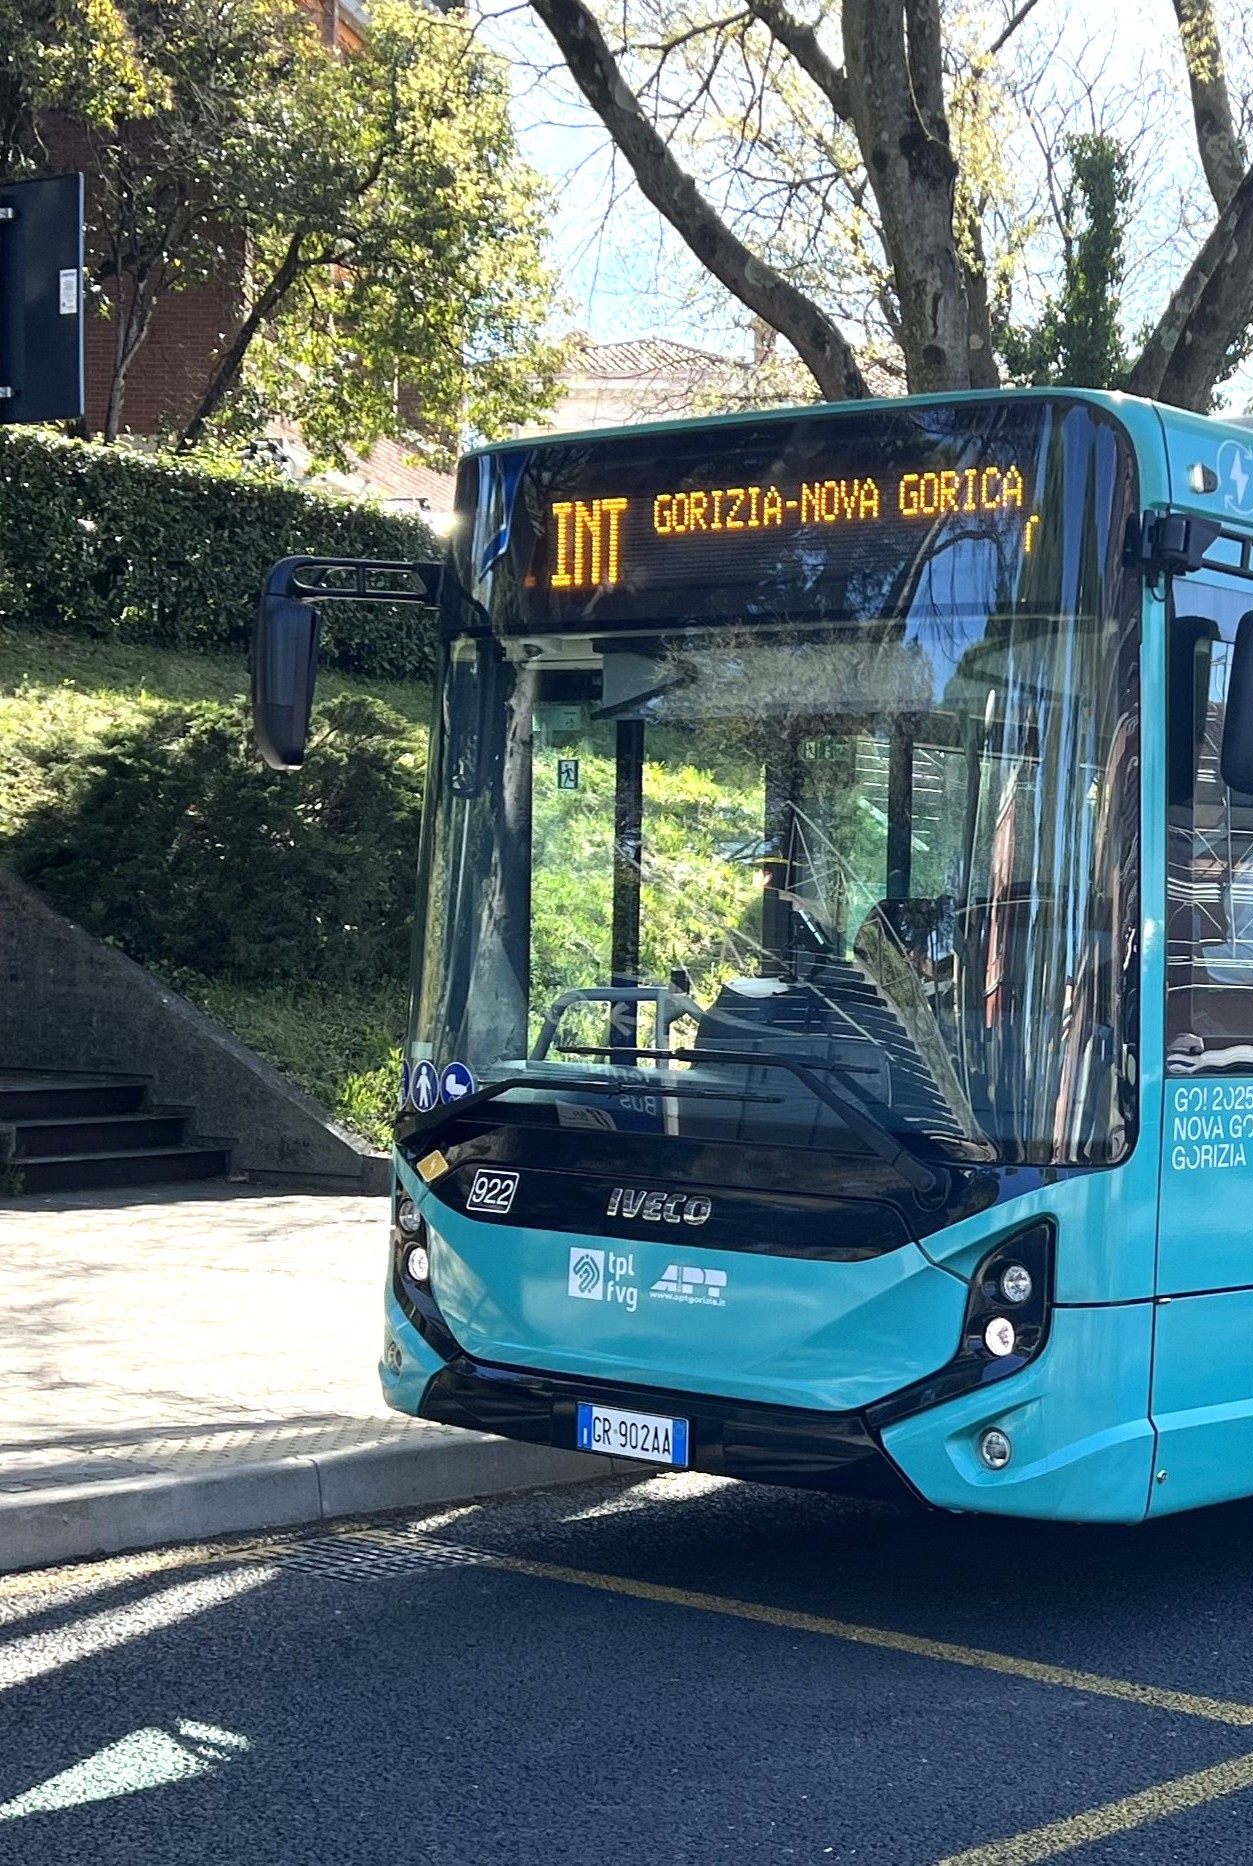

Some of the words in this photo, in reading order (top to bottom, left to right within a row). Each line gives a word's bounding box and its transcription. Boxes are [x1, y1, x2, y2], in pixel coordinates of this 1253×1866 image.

[653, 477, 880, 535] GORIZIA-NOVA
[899, 465, 1024, 517] GORICA
[551, 497, 628, 587] INT
[1174, 1087, 1207, 1112] GO!
[1174, 1115, 1225, 1141] NOVA
[1172, 1143, 1247, 1170] GORIZIA
[472, 1177, 514, 1207] 922
[606, 1187, 712, 1226] IVECO
[608, 1251, 635, 1281] tpl
[650, 1264, 728, 1298] APT
[606, 1280, 638, 1312] fvg
